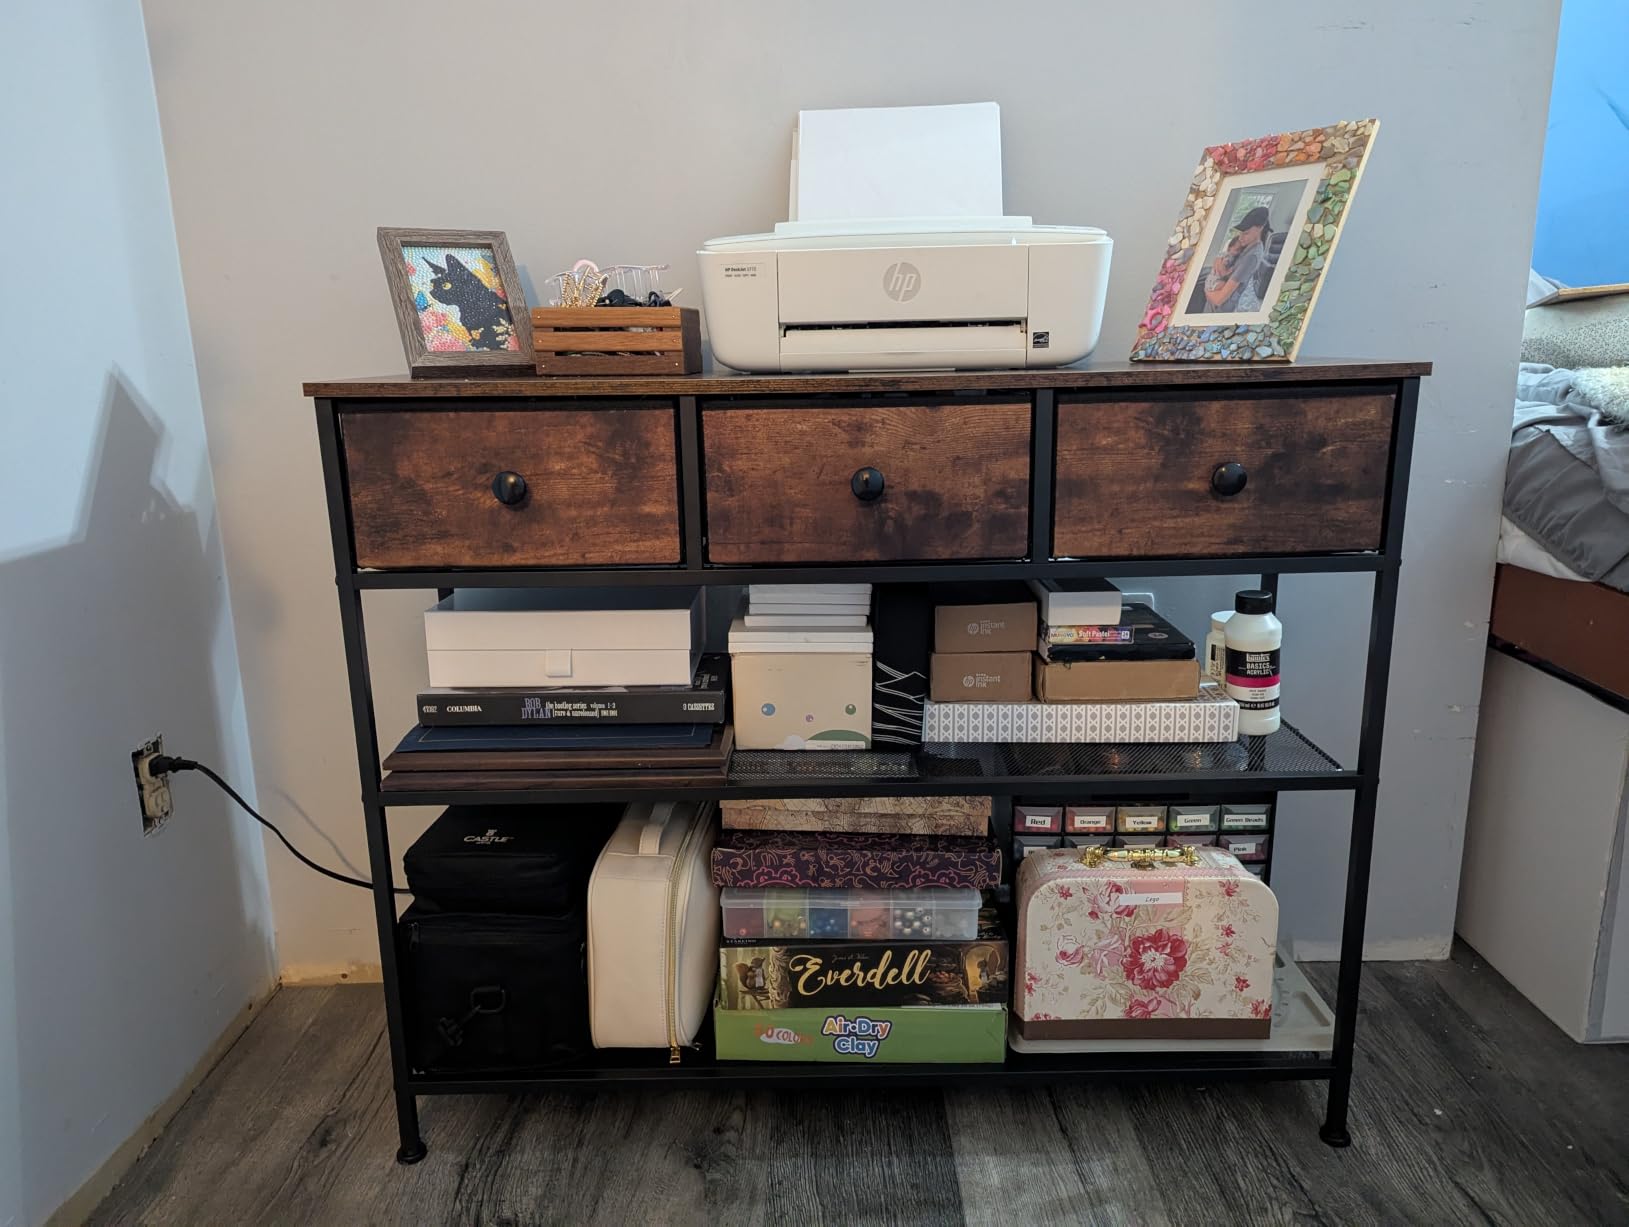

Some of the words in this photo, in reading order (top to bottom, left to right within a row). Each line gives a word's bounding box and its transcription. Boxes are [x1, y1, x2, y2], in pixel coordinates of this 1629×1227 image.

[1078, 630, 1091, 638] Soft
[1246, 662, 1270, 670] BASICS
[524, 698, 541, 709] BOB
[446, 705, 483, 713] COLUMBIA
[521, 708, 551, 719] DYLAN
[463, 835, 509, 843] CASTLE
[789, 950, 931, 996] Everdell
[833, 1036, 879, 1057] Clay
